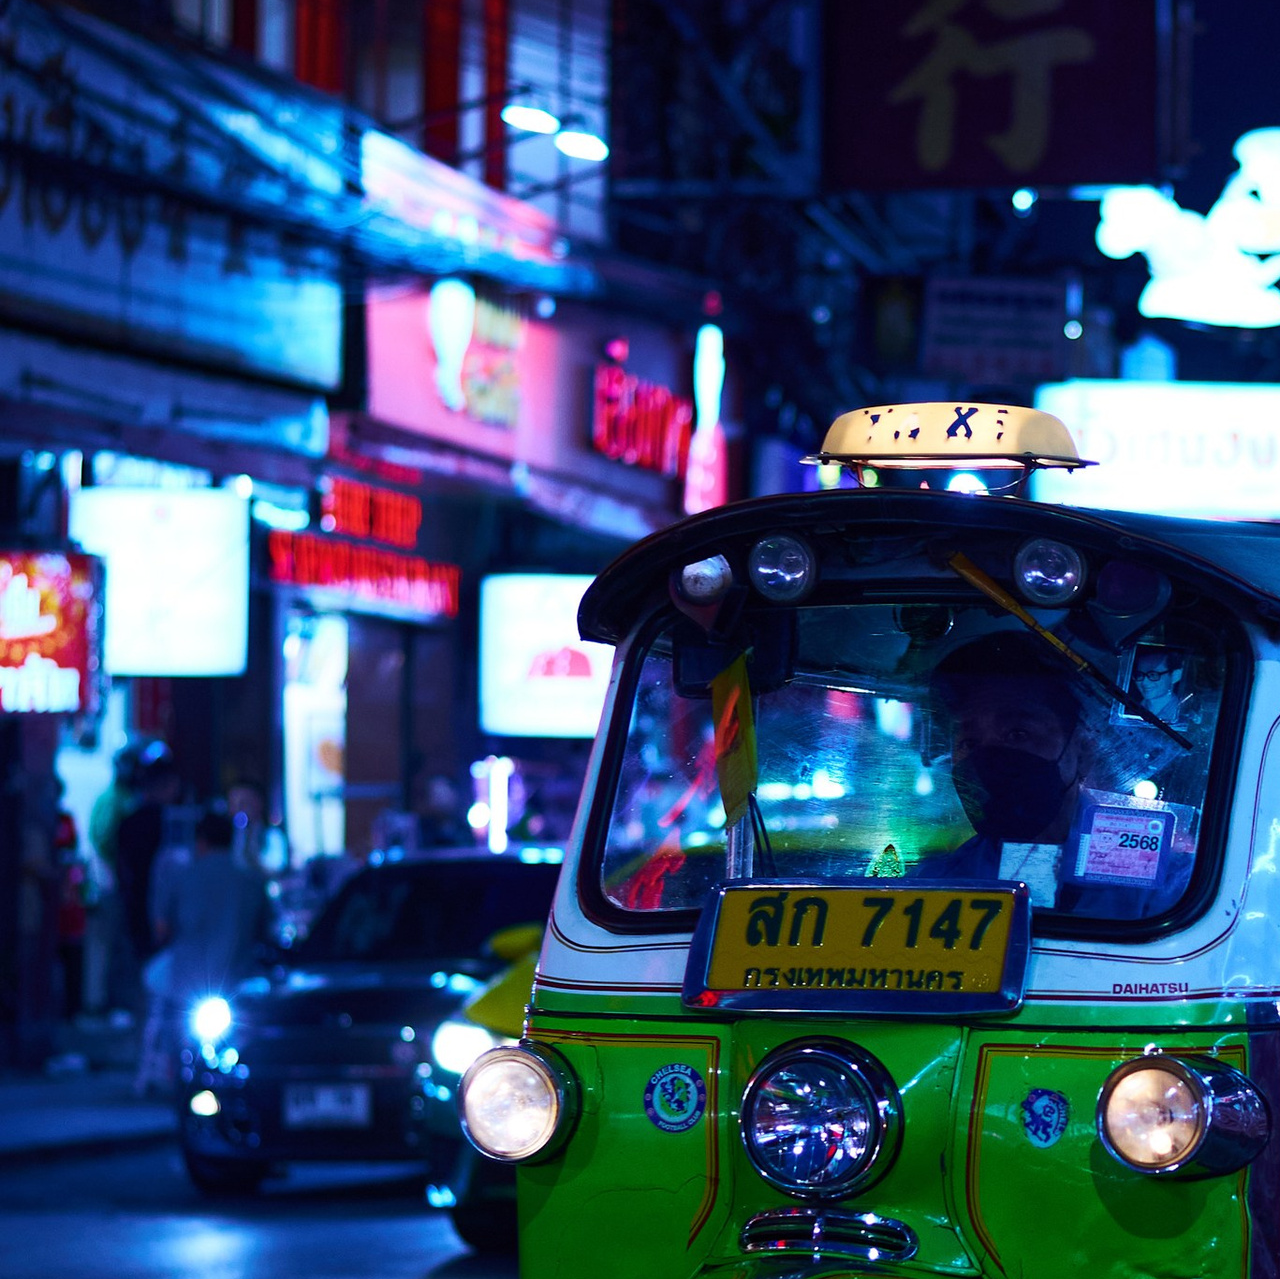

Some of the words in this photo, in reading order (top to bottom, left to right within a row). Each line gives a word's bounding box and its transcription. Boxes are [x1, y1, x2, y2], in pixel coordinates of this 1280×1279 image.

[1118, 833, 1160, 852] 2568
[745, 892, 829, 947] สก
[861, 897, 1003, 951] 7147
[743, 967, 964, 990] กรงเทพมหานคร
[1112, 982, 1189, 994] DAIHATSU
[650, 1064, 692, 1084] CHELSEA
